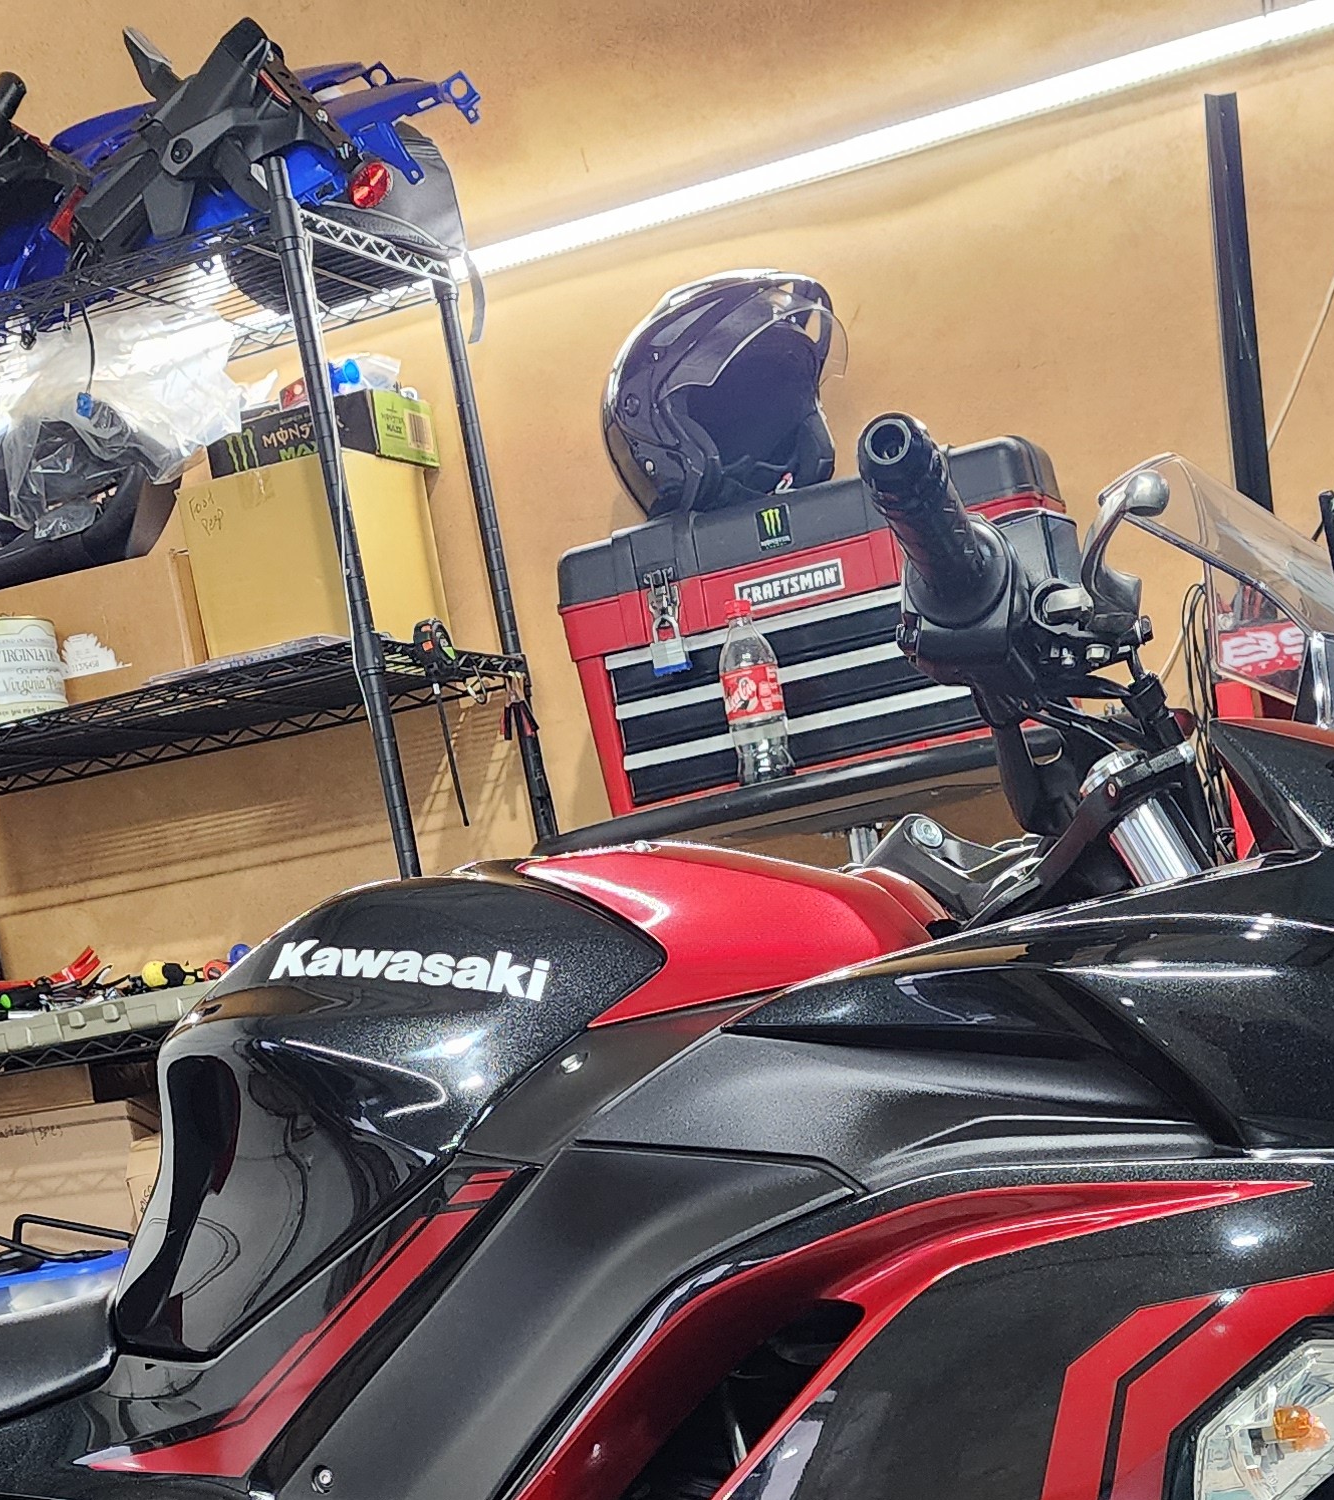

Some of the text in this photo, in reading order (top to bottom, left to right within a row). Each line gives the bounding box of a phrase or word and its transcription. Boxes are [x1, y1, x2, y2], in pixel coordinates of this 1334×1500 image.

[742, 565, 839, 603] CRAFTSMAN
[2, 674, 47, 696] Virginia
[268, 938, 551, 1003] Kawasaki
